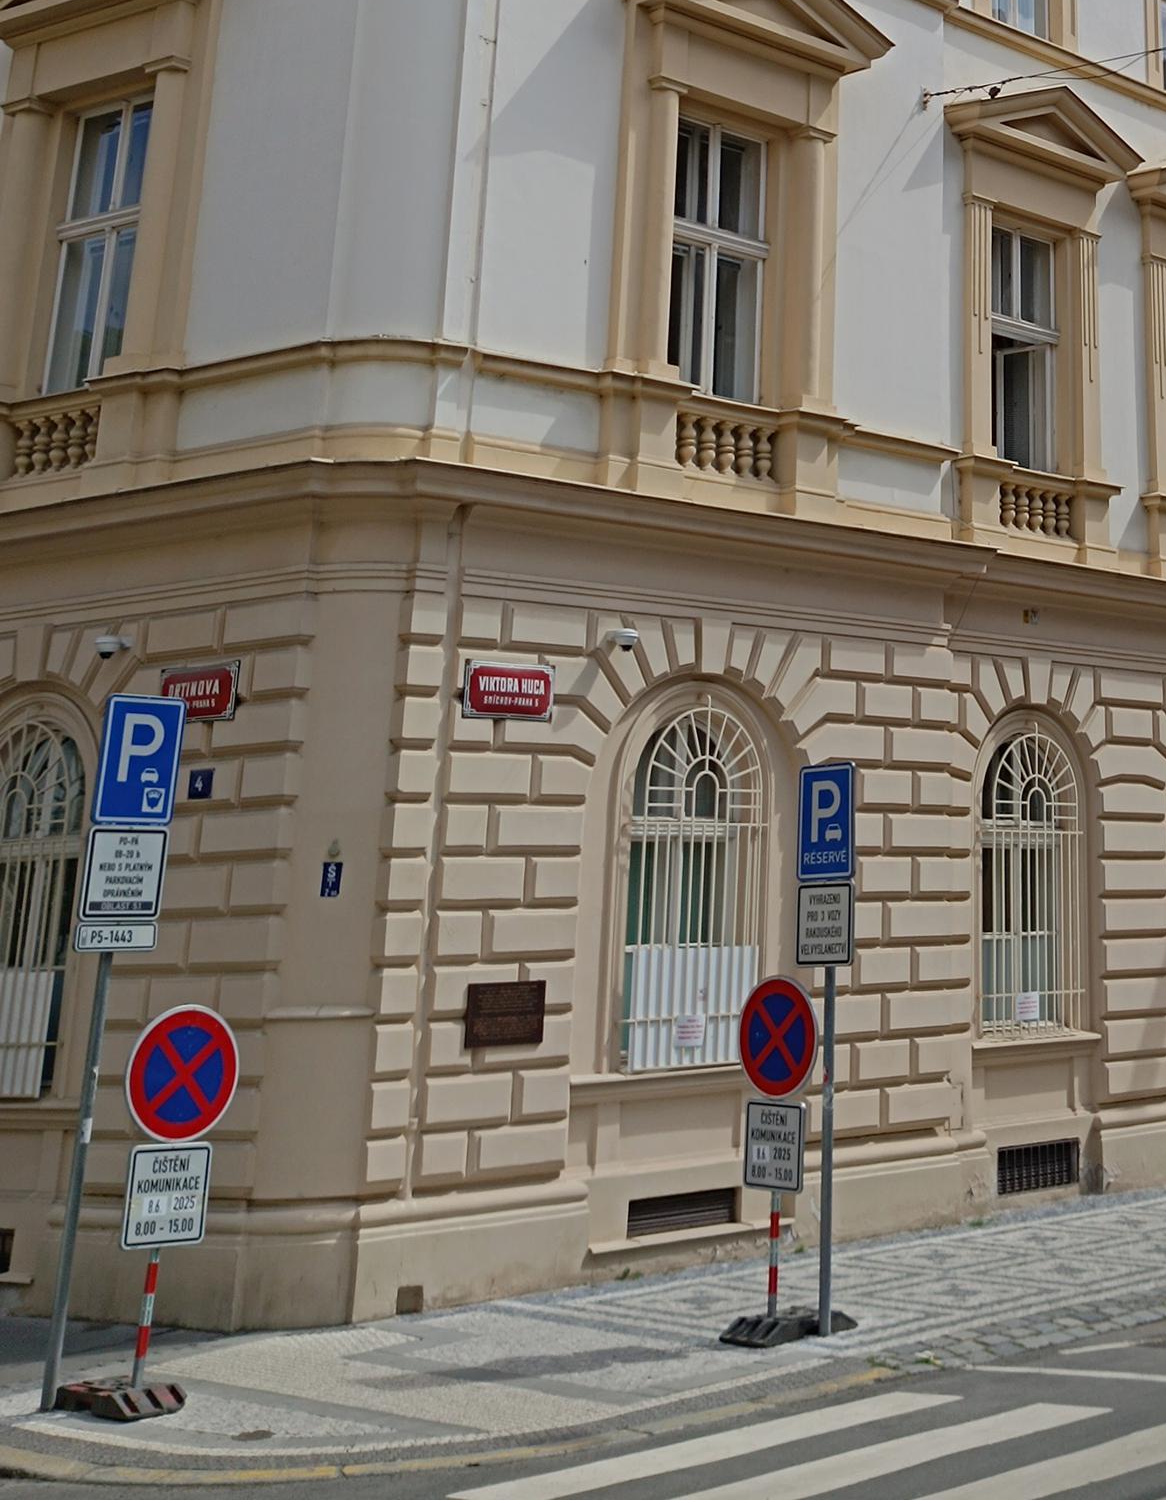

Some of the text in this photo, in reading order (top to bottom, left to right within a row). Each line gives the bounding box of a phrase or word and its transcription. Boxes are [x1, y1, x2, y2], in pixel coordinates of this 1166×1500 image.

[479, 675, 519, 693] VIKTORA
[116, 712, 165, 783] P
[194, 775, 204, 792] 4
[811, 780, 841, 843] P
[806, 910, 818, 922] PRO
[90, 930, 133, 943] P5-1443
[760, 1108, 788, 1126] ČIŠTĚNÍ
[751, 1127, 796, 1145] KOMUNIKACE
[773, 1146, 791, 1161] 2025
[152, 1154, 192, 1174] ČIŠTĚNÍ
[136, 1176, 201, 1194] KOMUNIKACE
[173, 1195, 196, 1211] 2025
